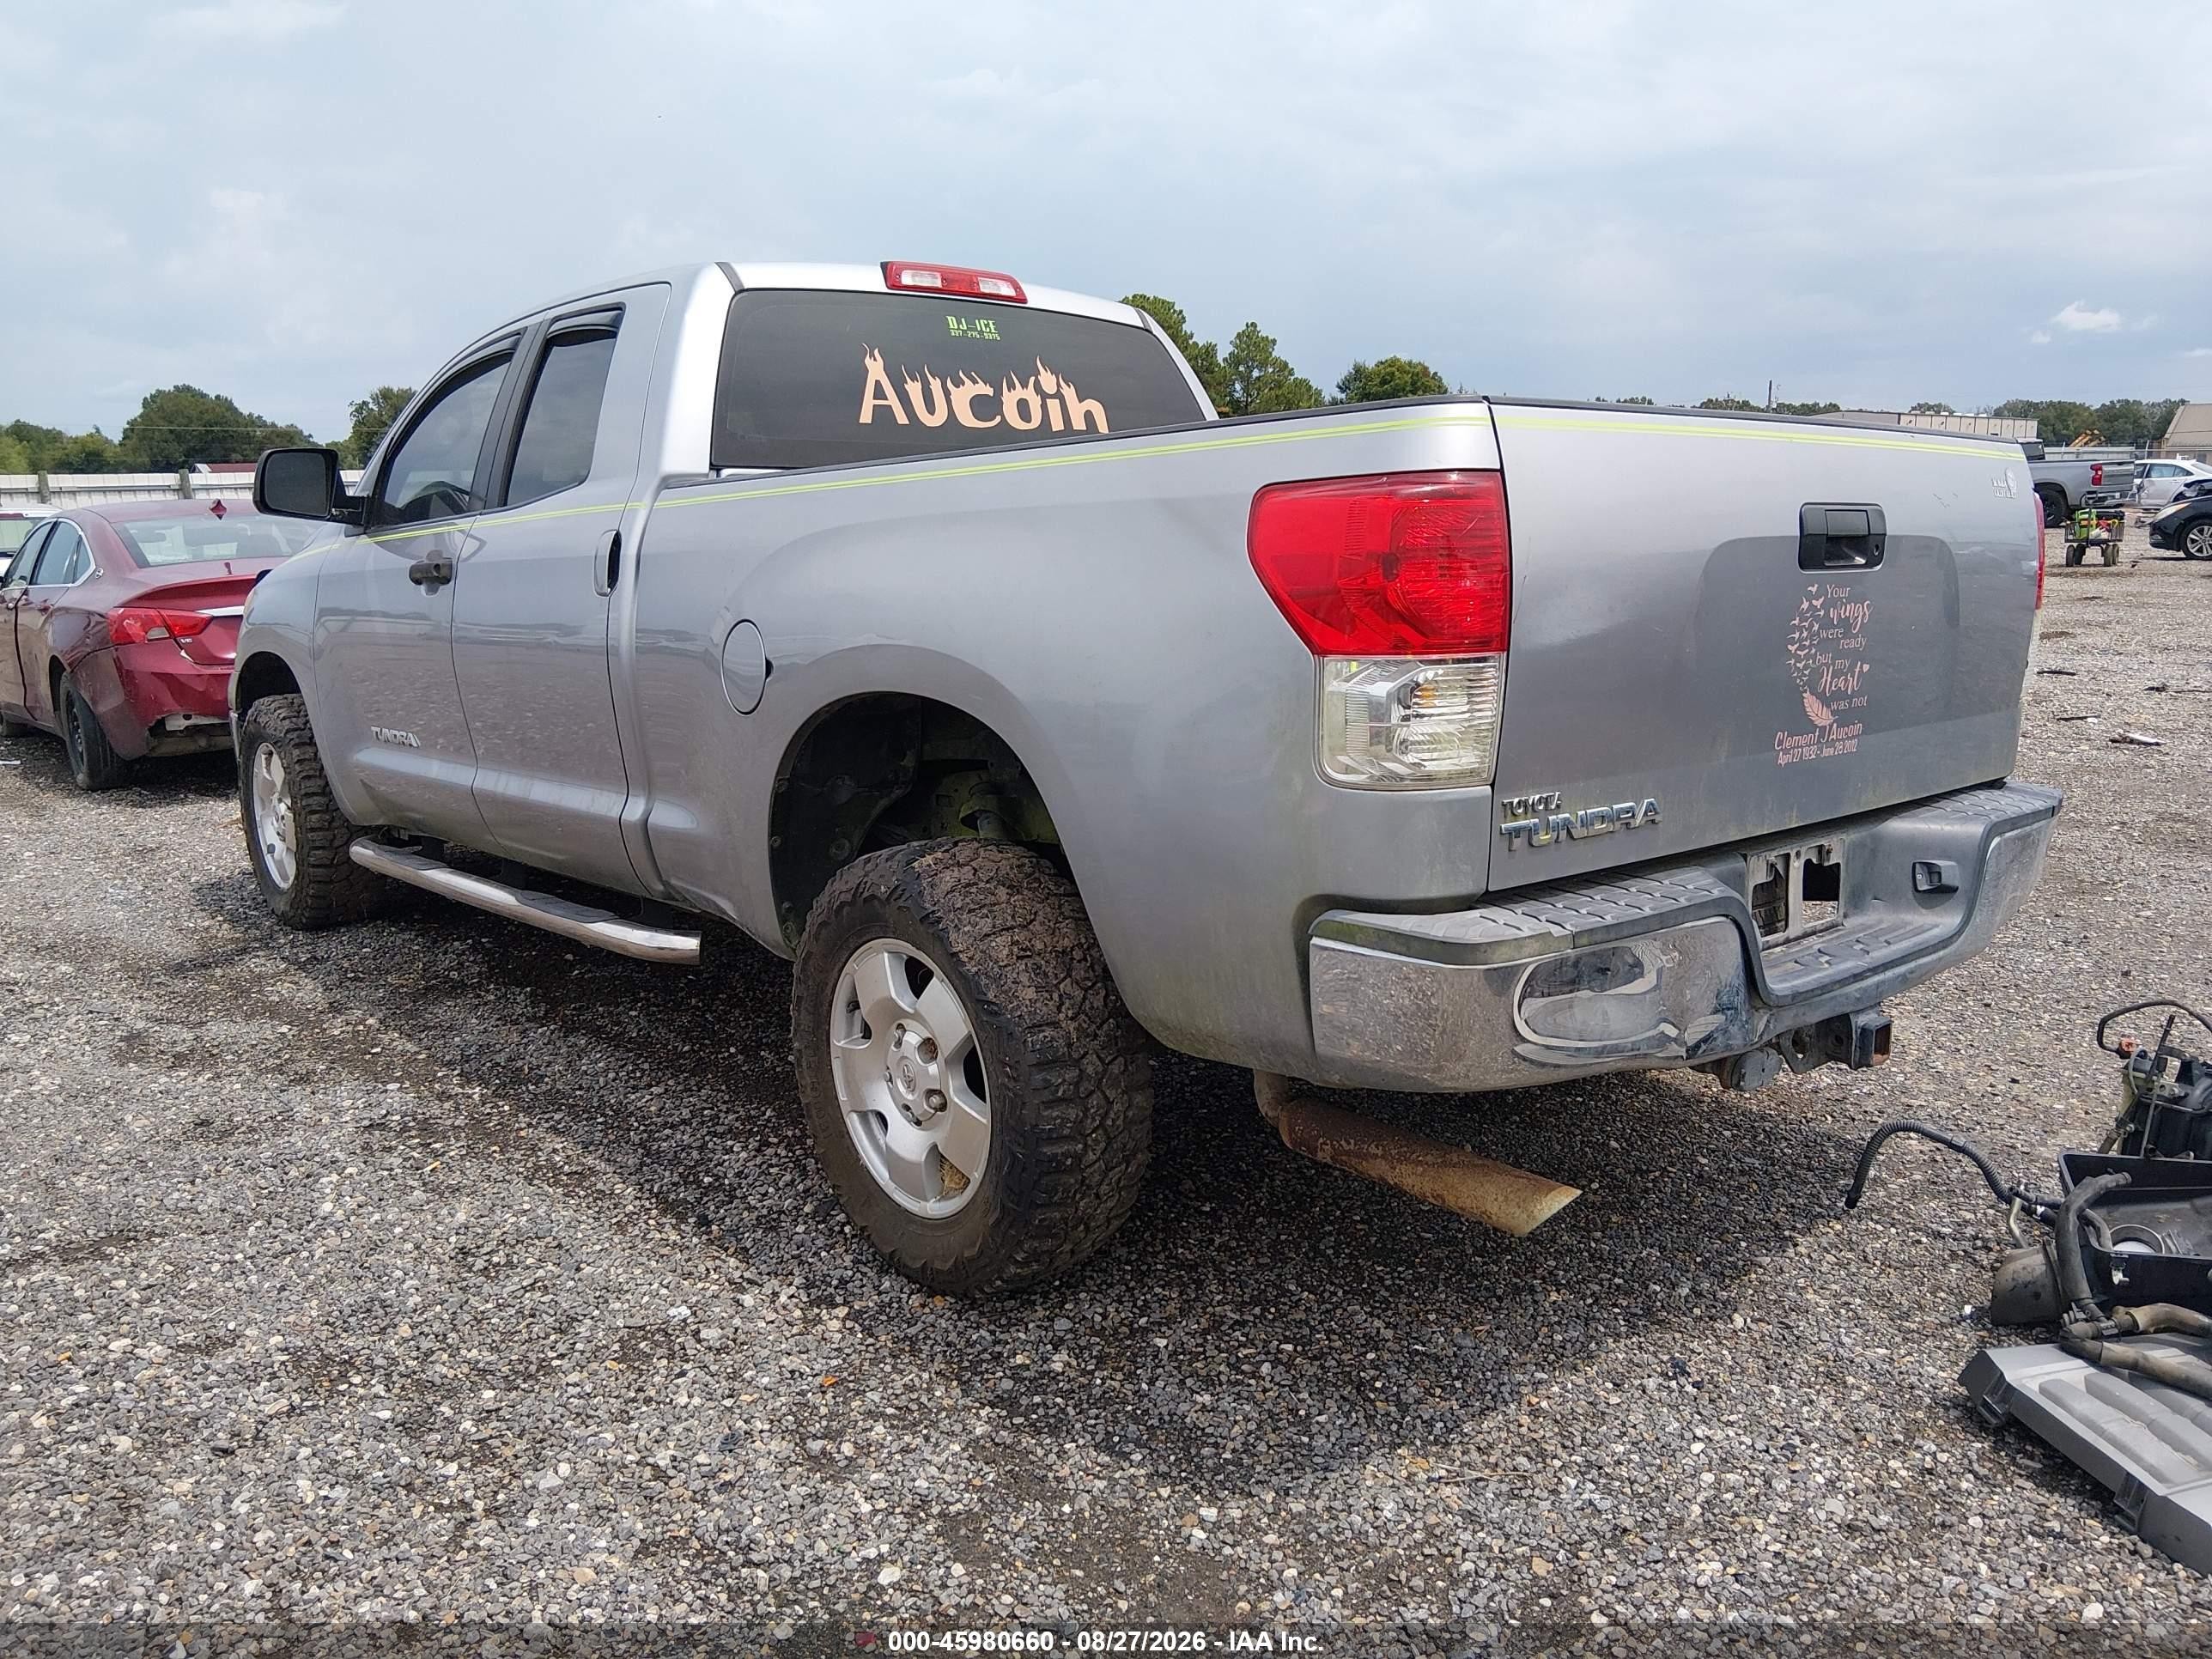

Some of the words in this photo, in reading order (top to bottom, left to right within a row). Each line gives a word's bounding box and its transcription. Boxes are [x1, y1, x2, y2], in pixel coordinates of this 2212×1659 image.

[859, 343, 1109, 434] Aucoin
[1826, 584, 1851, 599] Your
[1830, 598, 1874, 634] wings
[1820, 628, 1844, 639] were
[1839, 634, 1868, 651] ready
[1815, 652, 1832, 665] but
[1834, 659, 1851, 672] my
[1817, 660, 1863, 697] Heart
[1830, 698, 1850, 711] was
[1851, 694, 1869, 708] not
[370, 725, 422, 749] TUNDRA
[1774, 727, 1820, 750] Clement
[1820, 725, 1830, 743] J
[1829, 720, 1863, 742] Aucoin
[1778, 750, 1794, 768] April
[1502, 791, 1562, 817] TOYOTA
[1499, 798, 1662, 852] TUNDRA
